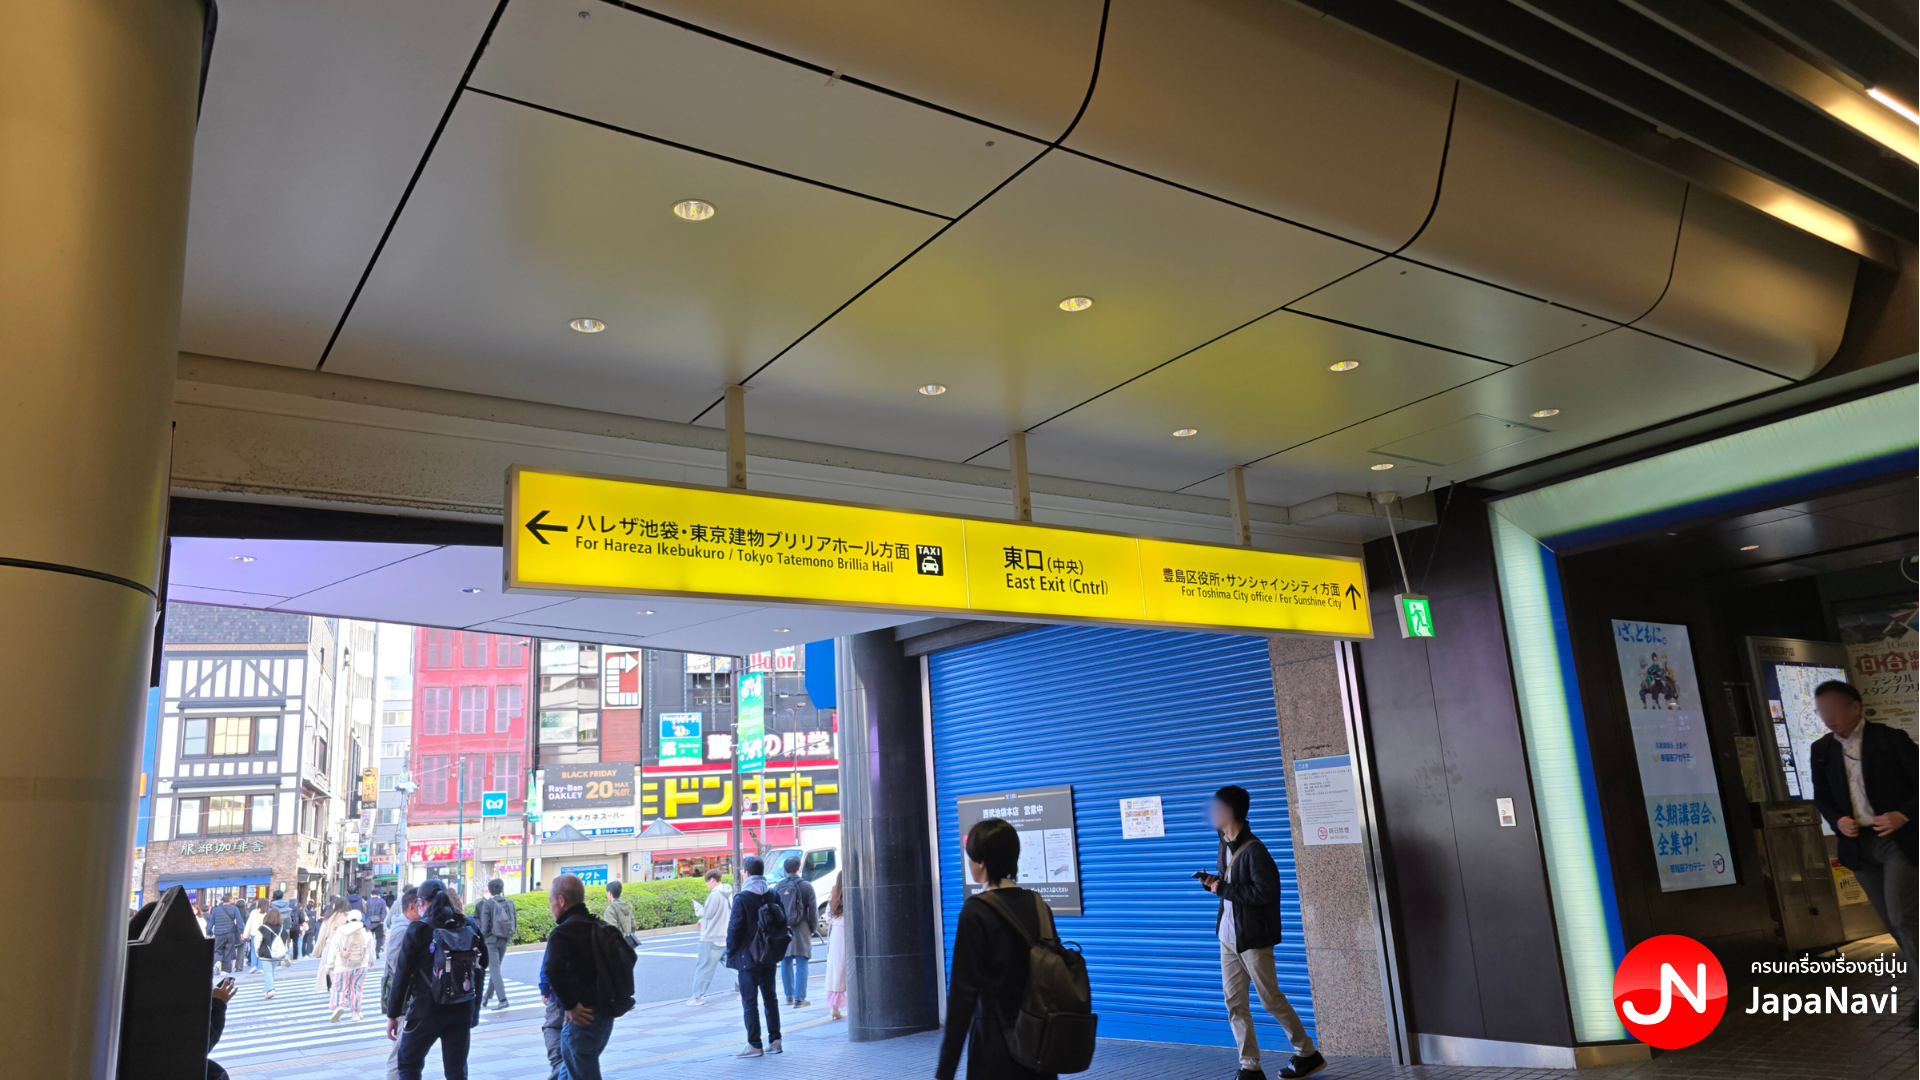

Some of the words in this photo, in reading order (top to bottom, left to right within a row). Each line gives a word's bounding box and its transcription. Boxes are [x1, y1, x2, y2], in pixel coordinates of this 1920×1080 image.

[576, 514, 911, 561] ハレザ池袋・東京建物ブリリアホール方面
[575, 536, 599, 550] For
[604, 538, 652, 554] Hareza
[657, 542, 725, 560] Ikebukuro
[728, 548, 734, 561] /
[737, 549, 773, 566] Tokyo
[777, 552, 834, 568] Tatemono
[837, 557, 869, 571] Brillia
[872, 561, 894, 573] Hall
[917, 545, 941, 556] TAXI
[1006, 573, 1036, 590] East
[1040, 575, 1066, 592] Exit
[1069, 578, 1109, 596] (Cntrl)
[1162, 567, 1341, 597] 豊島区役所・サンシャインシティ方面
[1181, 586, 1195, 596] For
[1197, 587, 1232, 600] Toshima
[1233, 590, 1249, 603] City
[1250, 592, 1273, 603] office
[1279, 594, 1292, 604] For
[1294, 595, 1327, 607] Sunshine
[1327, 598, 1342, 610] City
[561, 771, 589, 779] BLACK
[589, 769, 618, 778] FRIDAY
[548, 784, 583, 793] Ray-Ban
[548, 792, 583, 800] OAKLEY
[585, 780, 614, 800] 20
[576, 812, 625, 822] メガネスーパー
